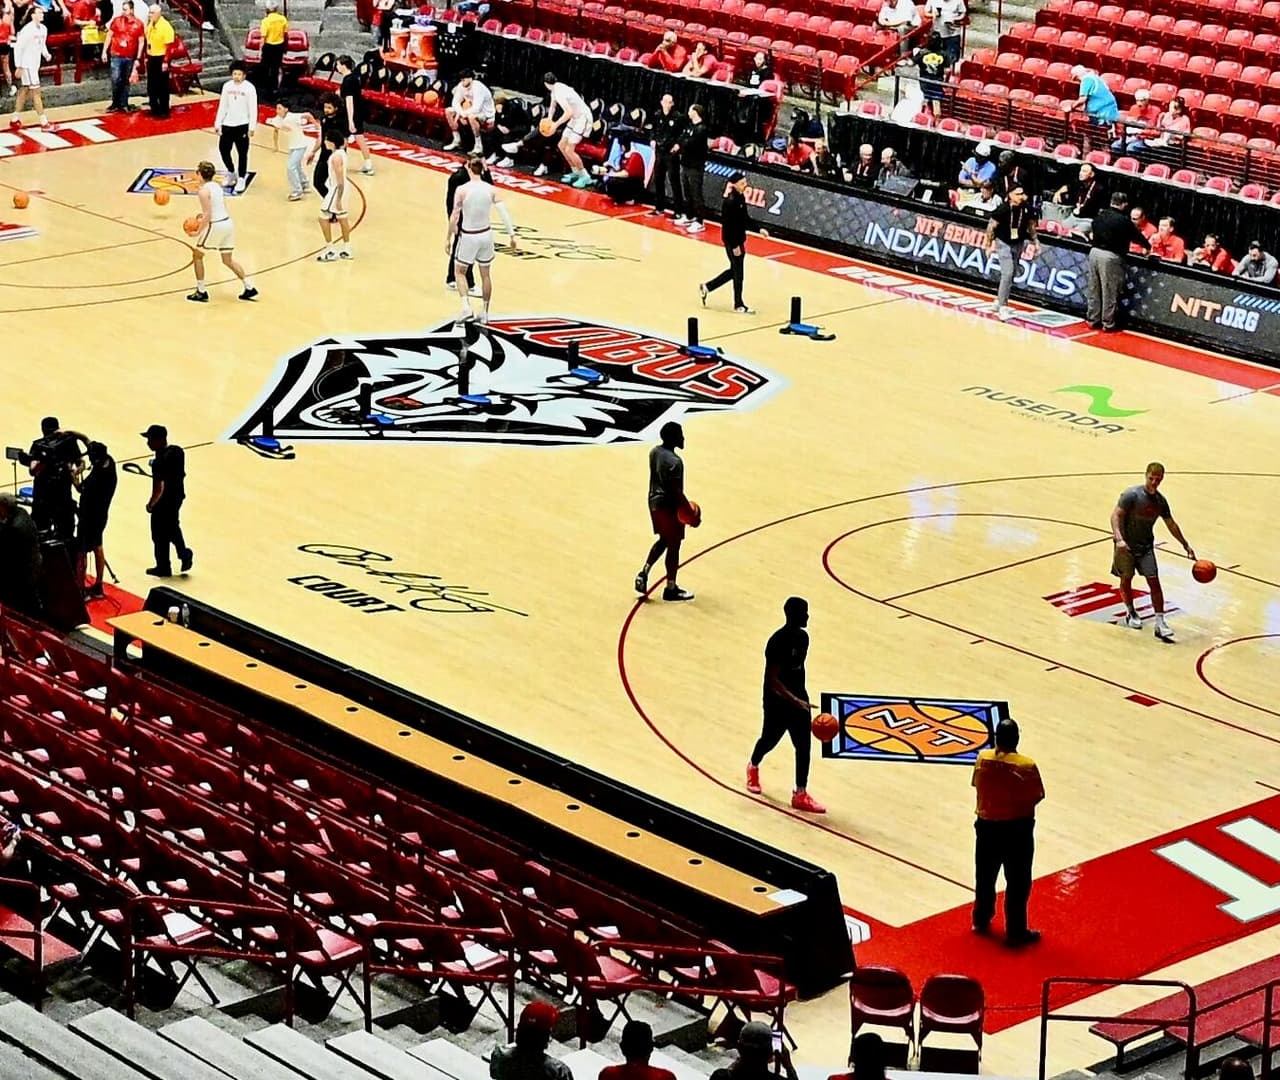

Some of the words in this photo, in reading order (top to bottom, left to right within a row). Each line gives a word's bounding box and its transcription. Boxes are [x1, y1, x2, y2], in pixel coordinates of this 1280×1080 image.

[768, 190, 785, 215] 2
[913, 216, 944, 237] NIT
[1171, 292, 1261, 332] NIT.ORG
[488, 316, 761, 401] LOBOS
[287, 574, 407, 614] COURT
[861, 708, 975, 747] NIT
